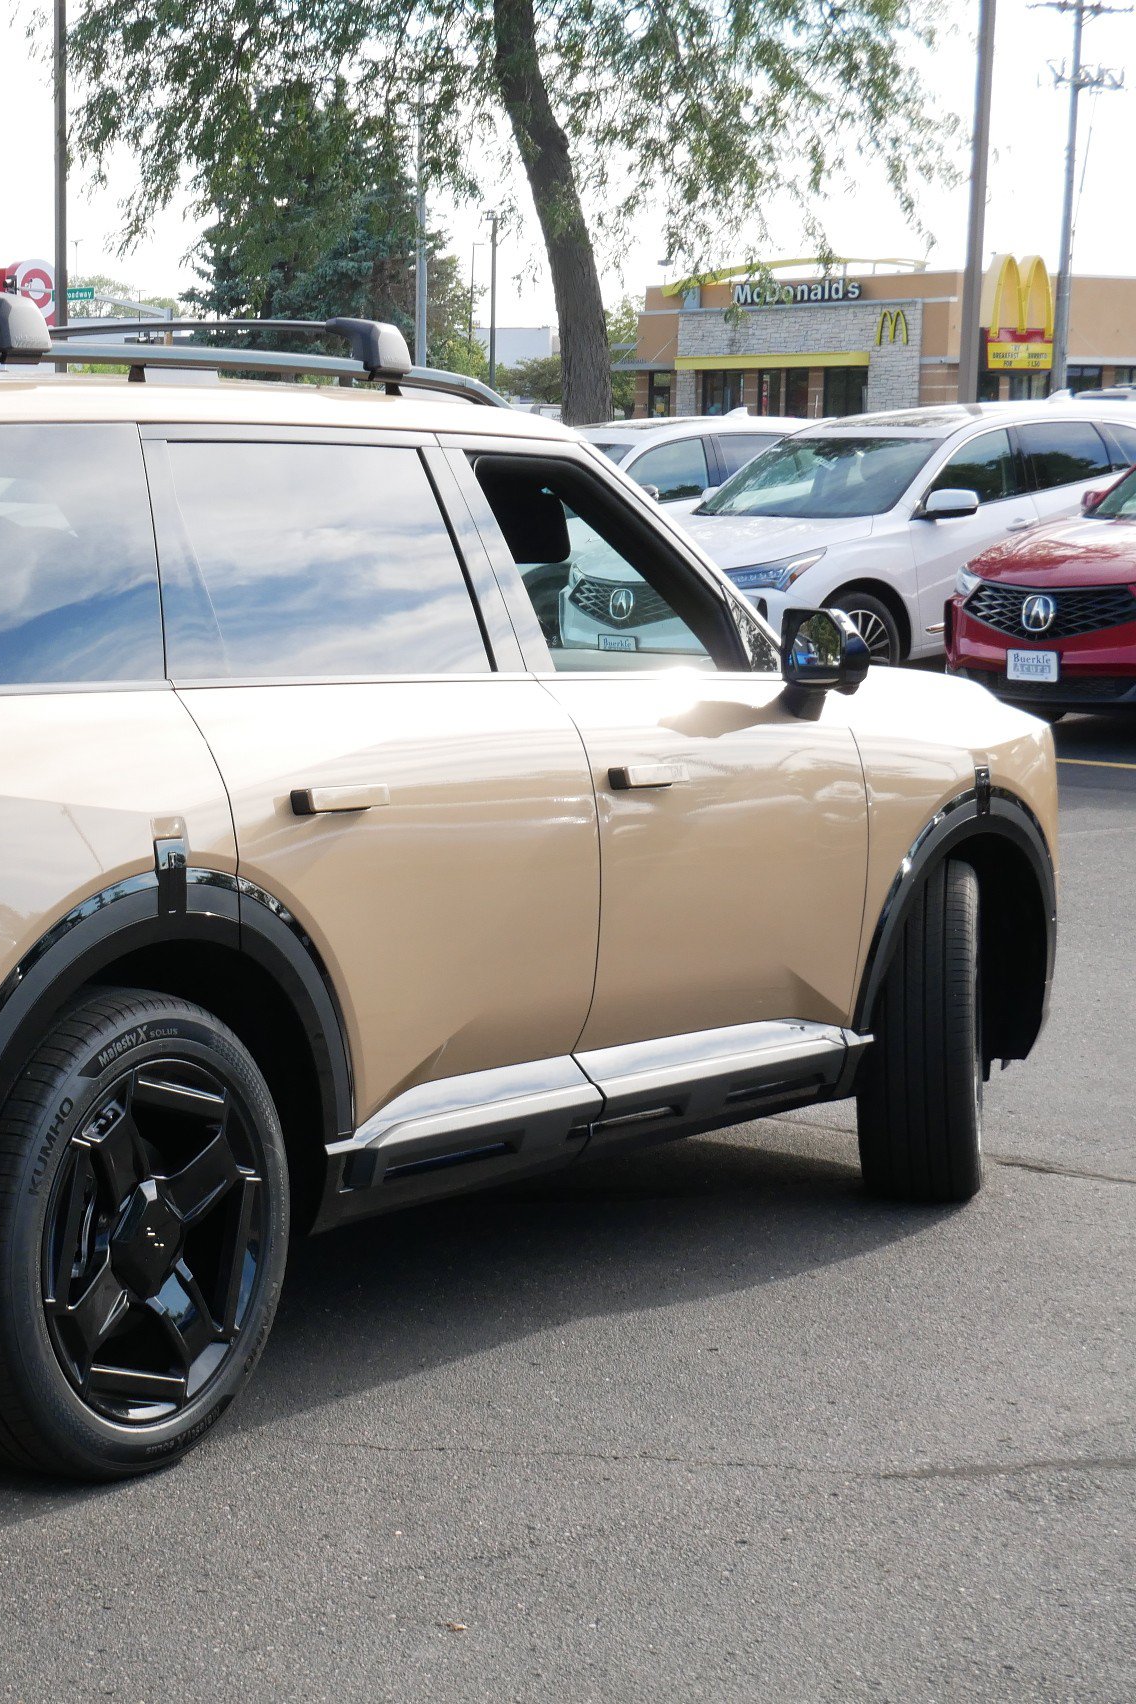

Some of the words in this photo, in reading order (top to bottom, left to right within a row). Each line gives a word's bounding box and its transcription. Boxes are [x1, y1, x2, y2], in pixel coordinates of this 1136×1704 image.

[733, 279, 861, 304] McDonalds
[1013, 653, 1051, 665] Buerkle
[149, 1028, 178, 1038] SOLUS
[28, 1096, 74, 1196] KUMHO
